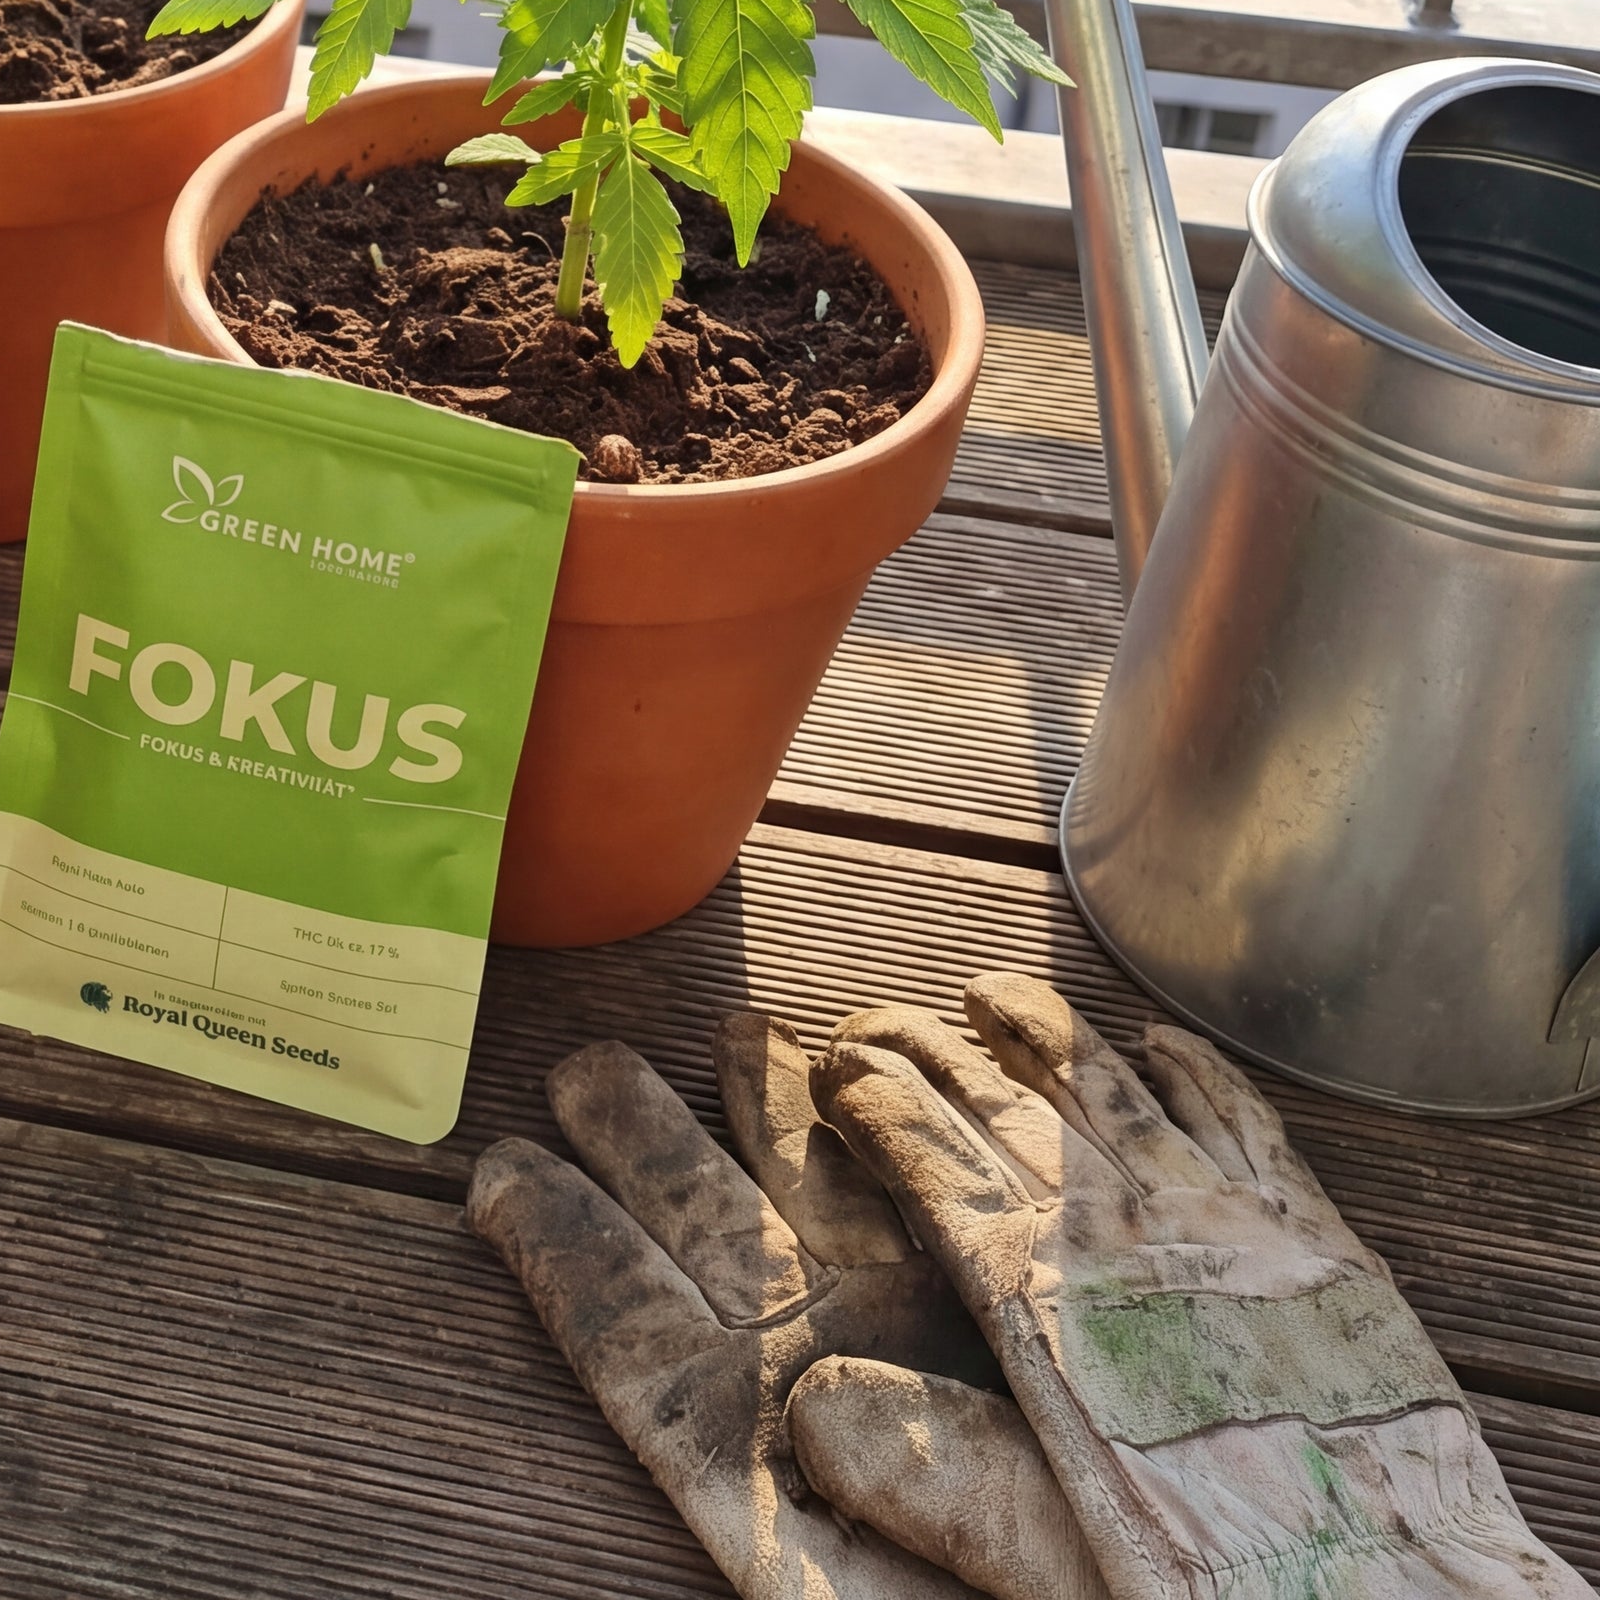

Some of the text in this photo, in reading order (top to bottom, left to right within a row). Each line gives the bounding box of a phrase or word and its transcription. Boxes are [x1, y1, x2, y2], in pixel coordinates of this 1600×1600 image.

[200, 509, 301, 554] GREEN
[69, 613, 467, 783] FOKUS
[139, 733, 204, 763] FOKUS
[293, 927, 323, 945] THC
[369, 944, 385, 957] 17
[123, 995, 187, 1027] Royal
[192, 1014, 266, 1050] Queen
[271, 1036, 340, 1070] Seeds
